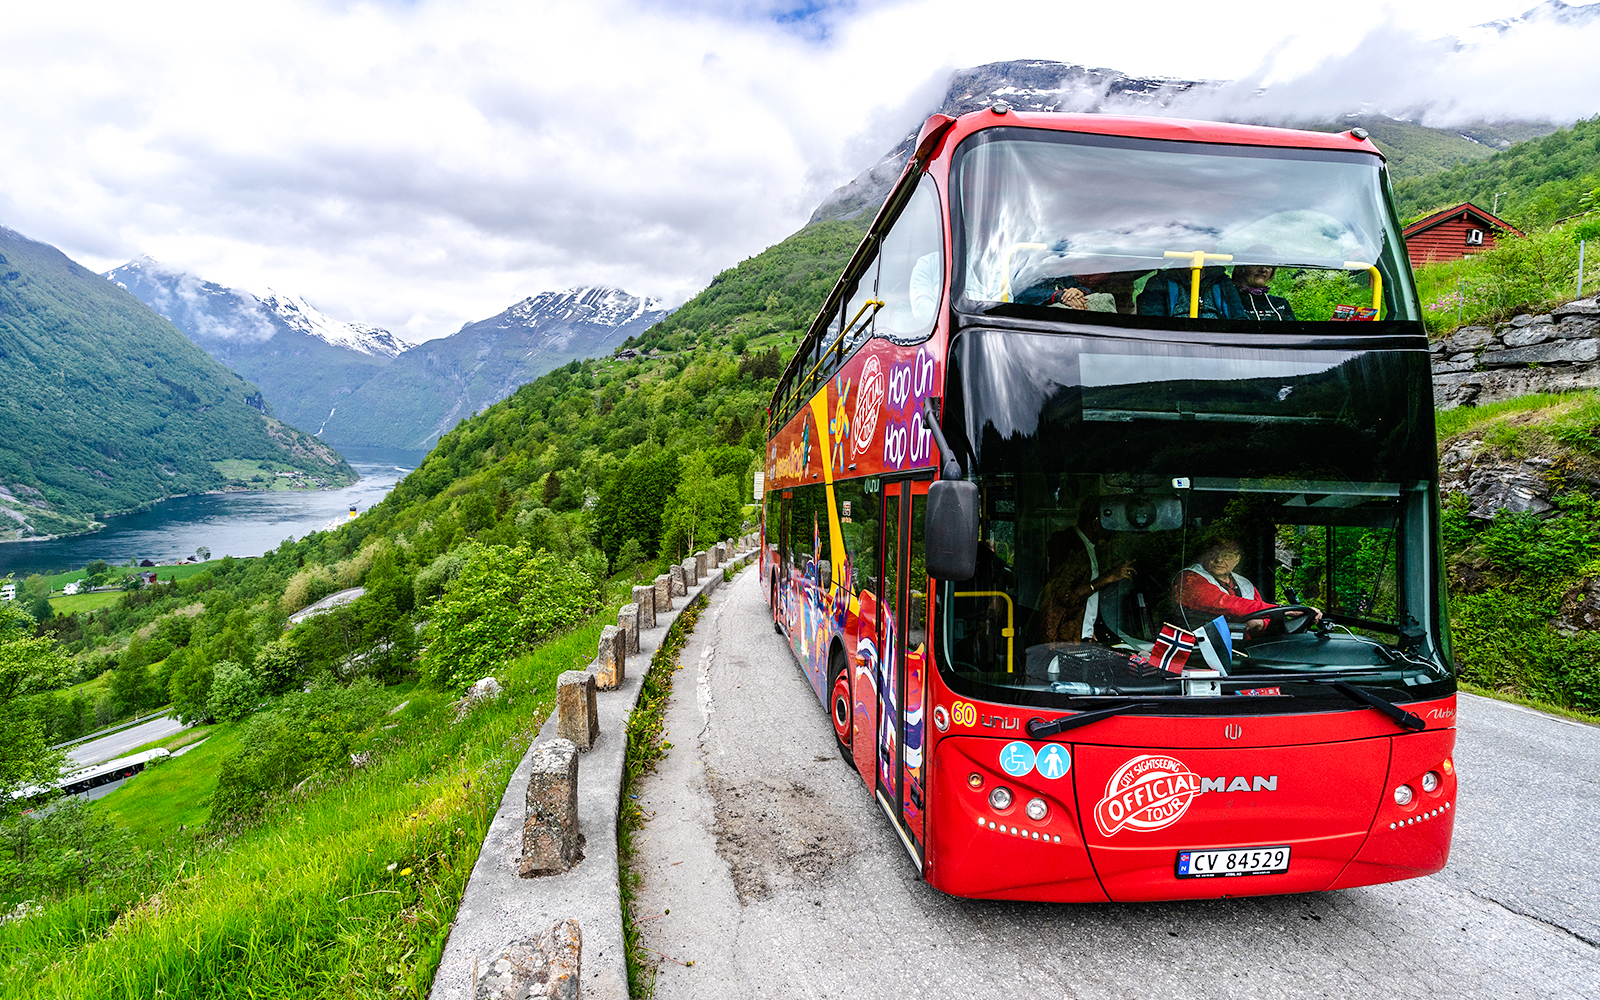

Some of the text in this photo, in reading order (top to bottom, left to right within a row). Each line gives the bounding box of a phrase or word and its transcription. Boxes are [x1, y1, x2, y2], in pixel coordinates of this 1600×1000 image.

[888, 366, 911, 409] Hop
[914, 347, 934, 398] On
[884, 424, 907, 470] Hop
[951, 701, 977, 727] 60
[1120, 758, 1180, 788] CITY SIGHTSEEING
[1200, 775, 1278, 793] MAN
[1108, 775, 1201, 821] OFFICIAL
[1145, 797, 1184, 821] TOUR
[1194, 851, 1284, 871] CV 84529
